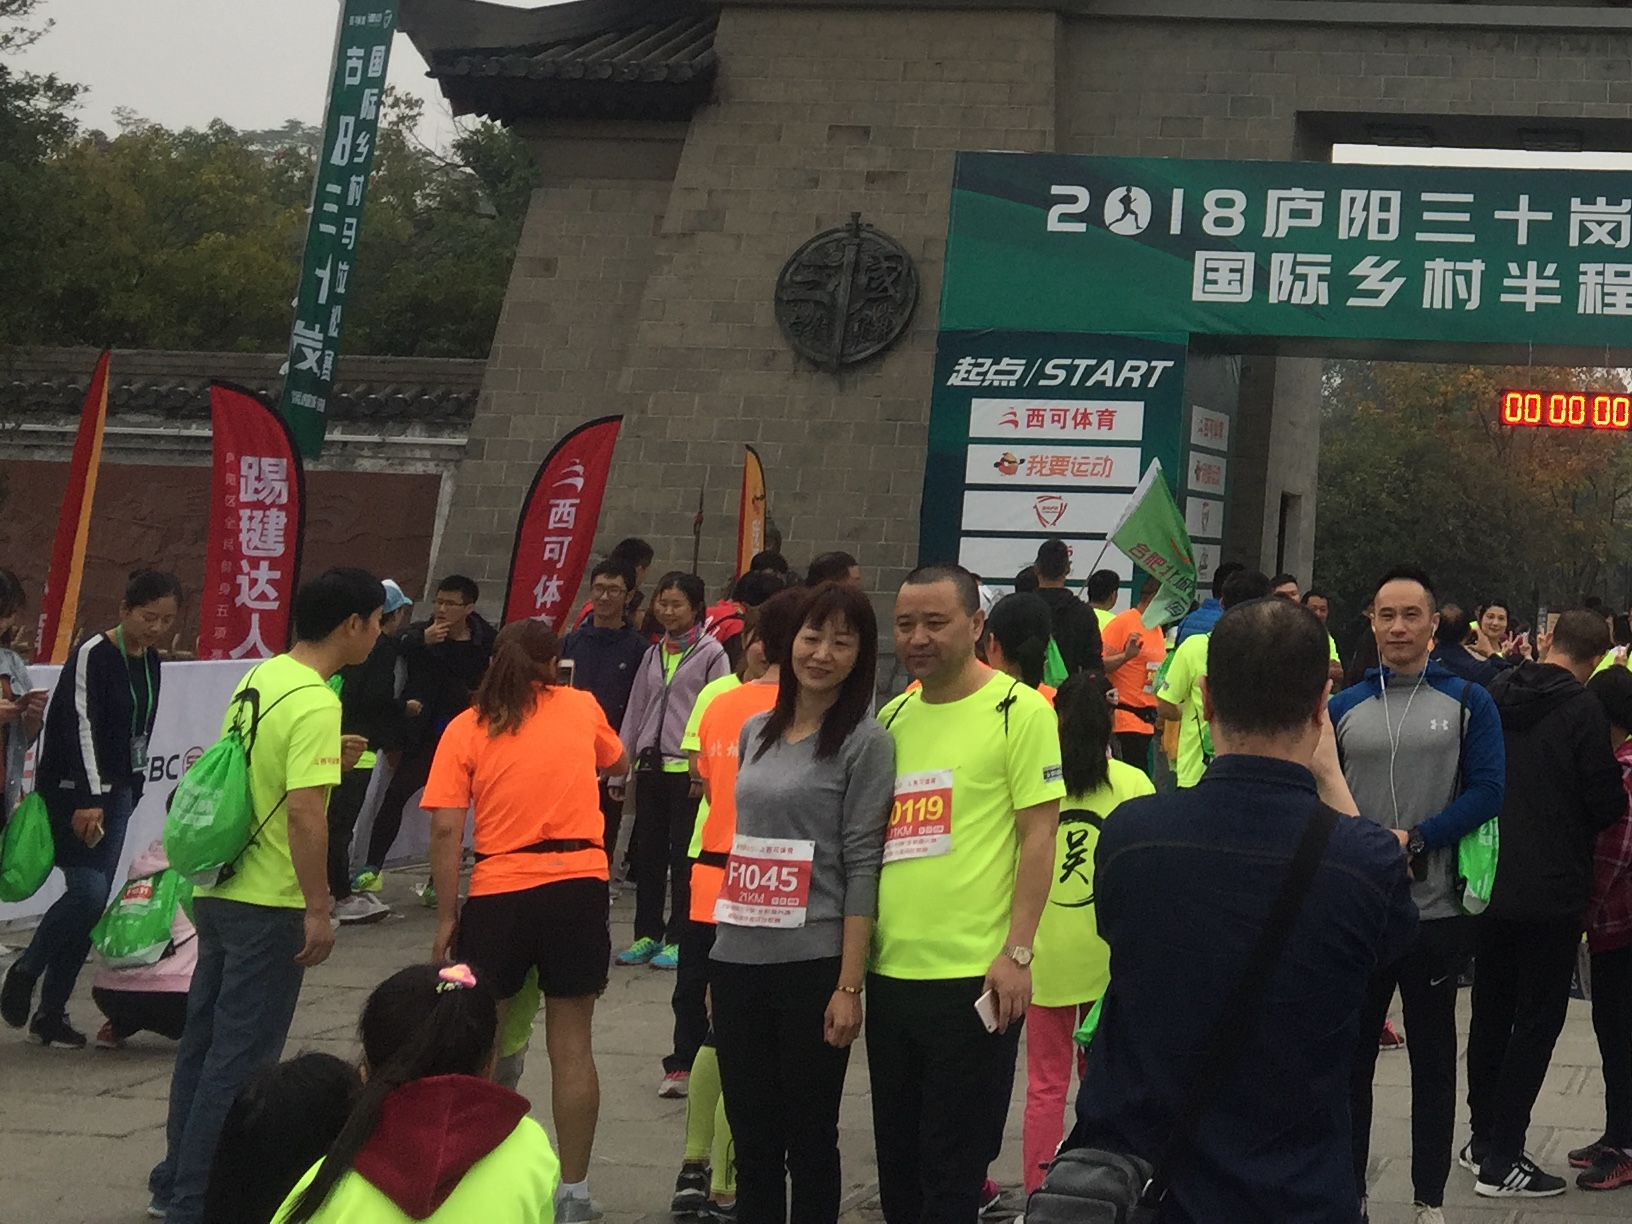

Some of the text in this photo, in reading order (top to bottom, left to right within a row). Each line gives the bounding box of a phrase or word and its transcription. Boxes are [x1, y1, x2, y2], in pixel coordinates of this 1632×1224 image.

[1026, 407, 1117, 431] 西可体育
[1026, 454, 1114, 478] 我要运动
[146, 753, 180, 783] BC
[728, 861, 799, 893] F1045
